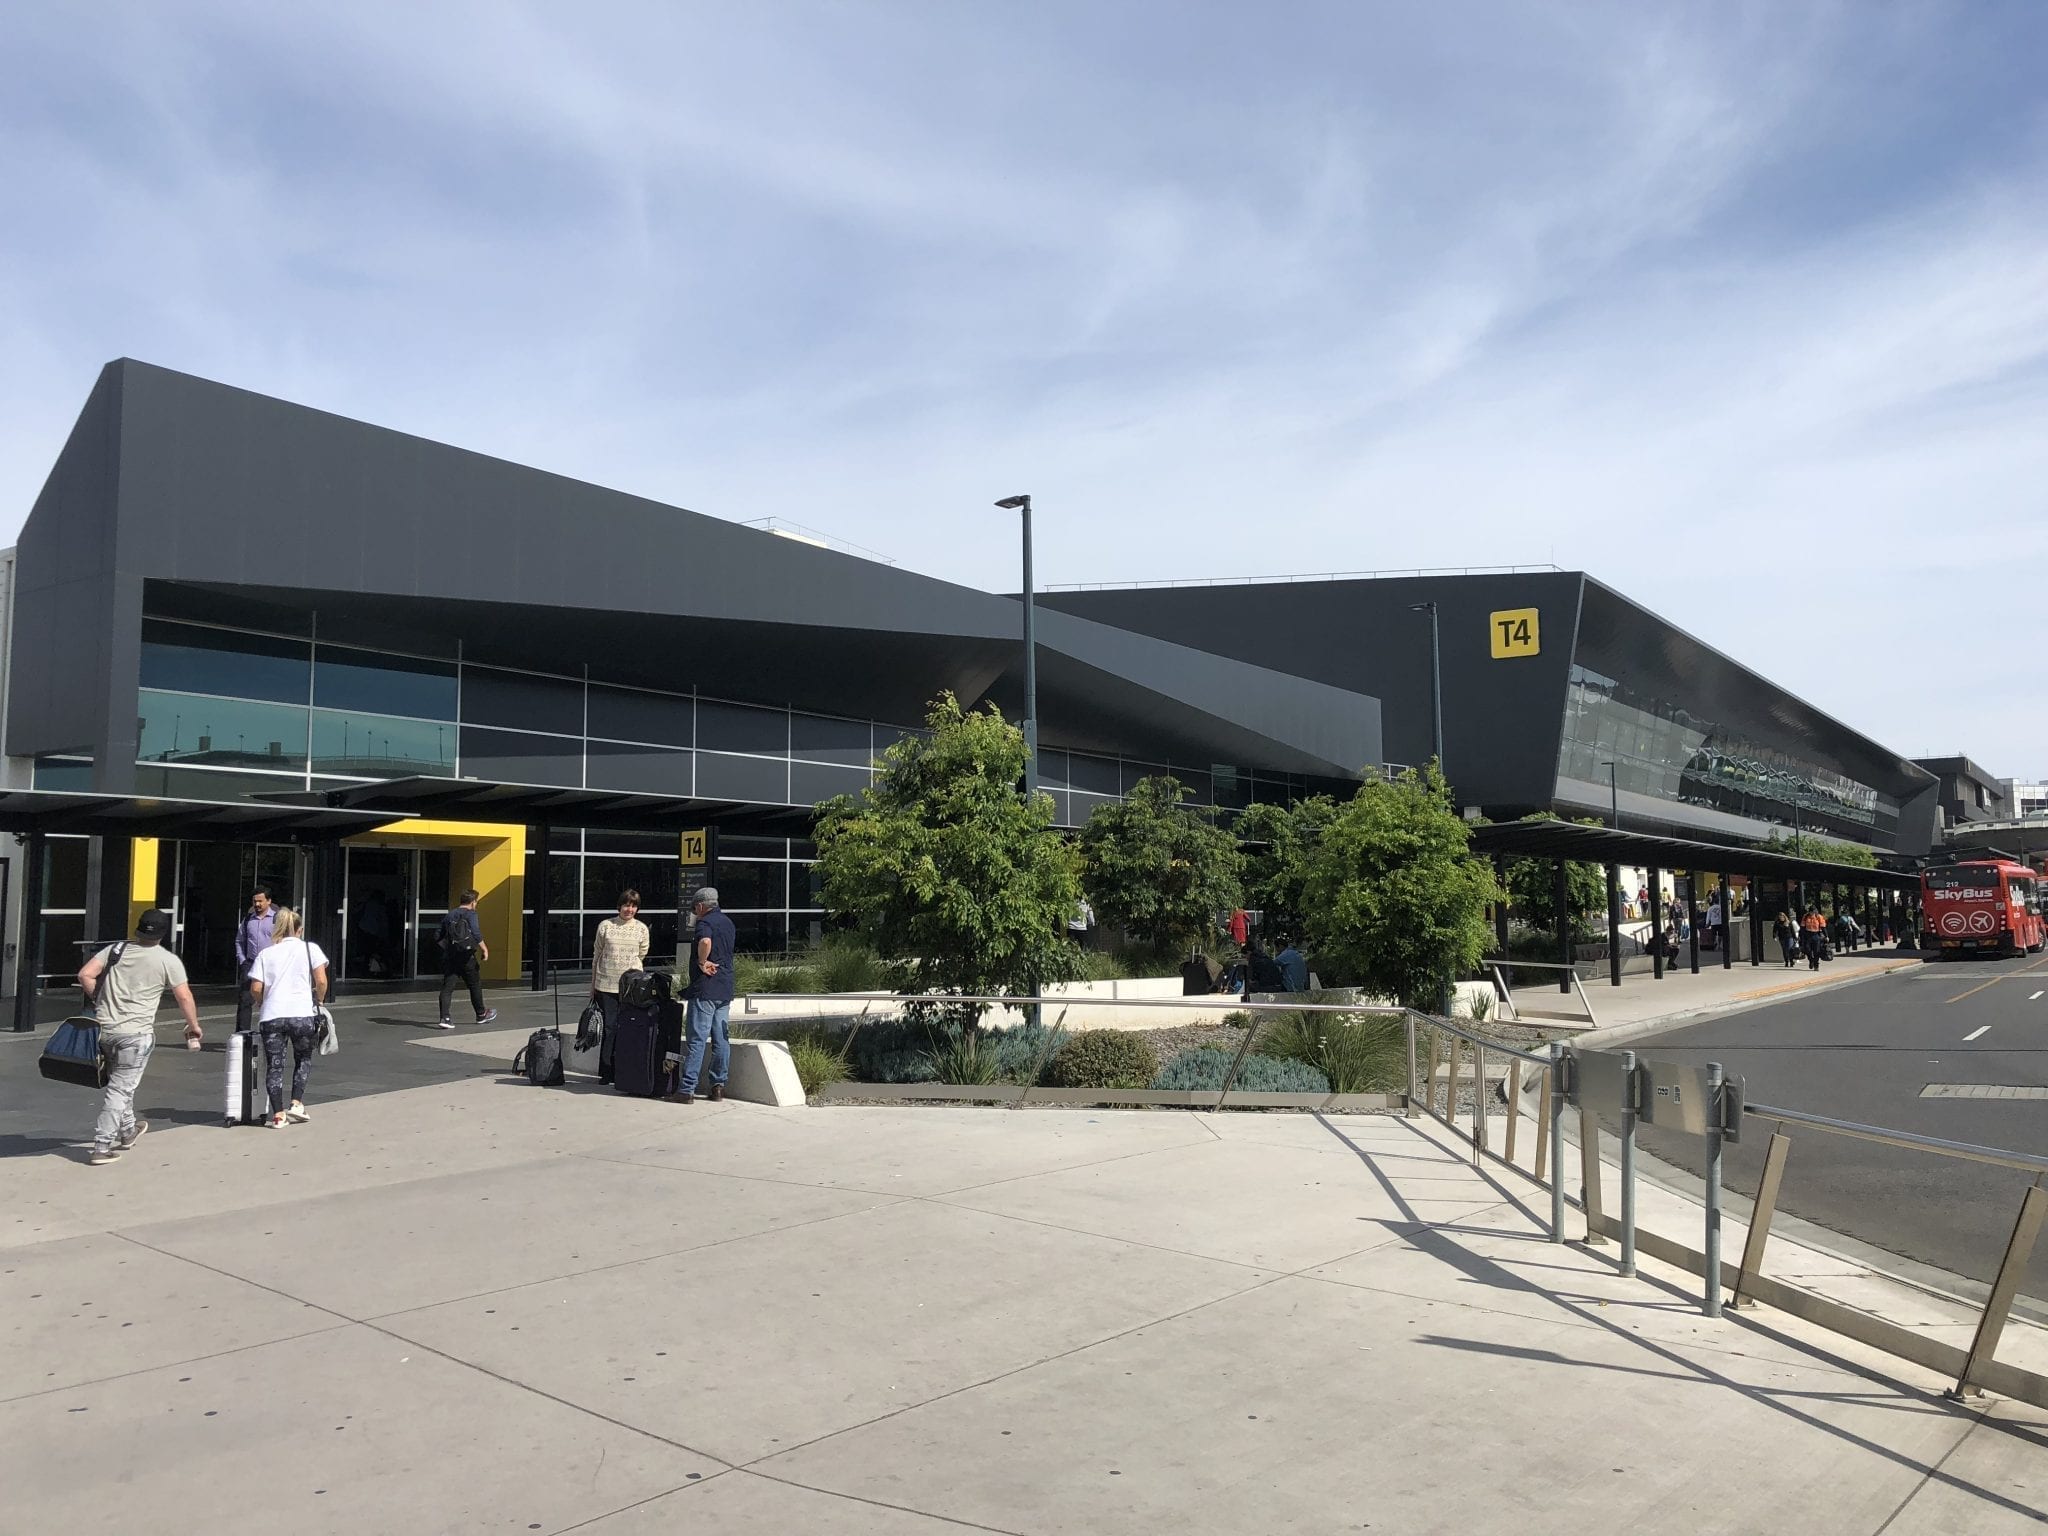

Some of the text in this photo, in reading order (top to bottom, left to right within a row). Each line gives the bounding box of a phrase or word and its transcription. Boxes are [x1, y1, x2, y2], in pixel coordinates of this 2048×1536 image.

[1498, 619, 1531, 647] T4
[684, 837, 703, 858] T4
[1934, 888, 1993, 900] SkyBus
